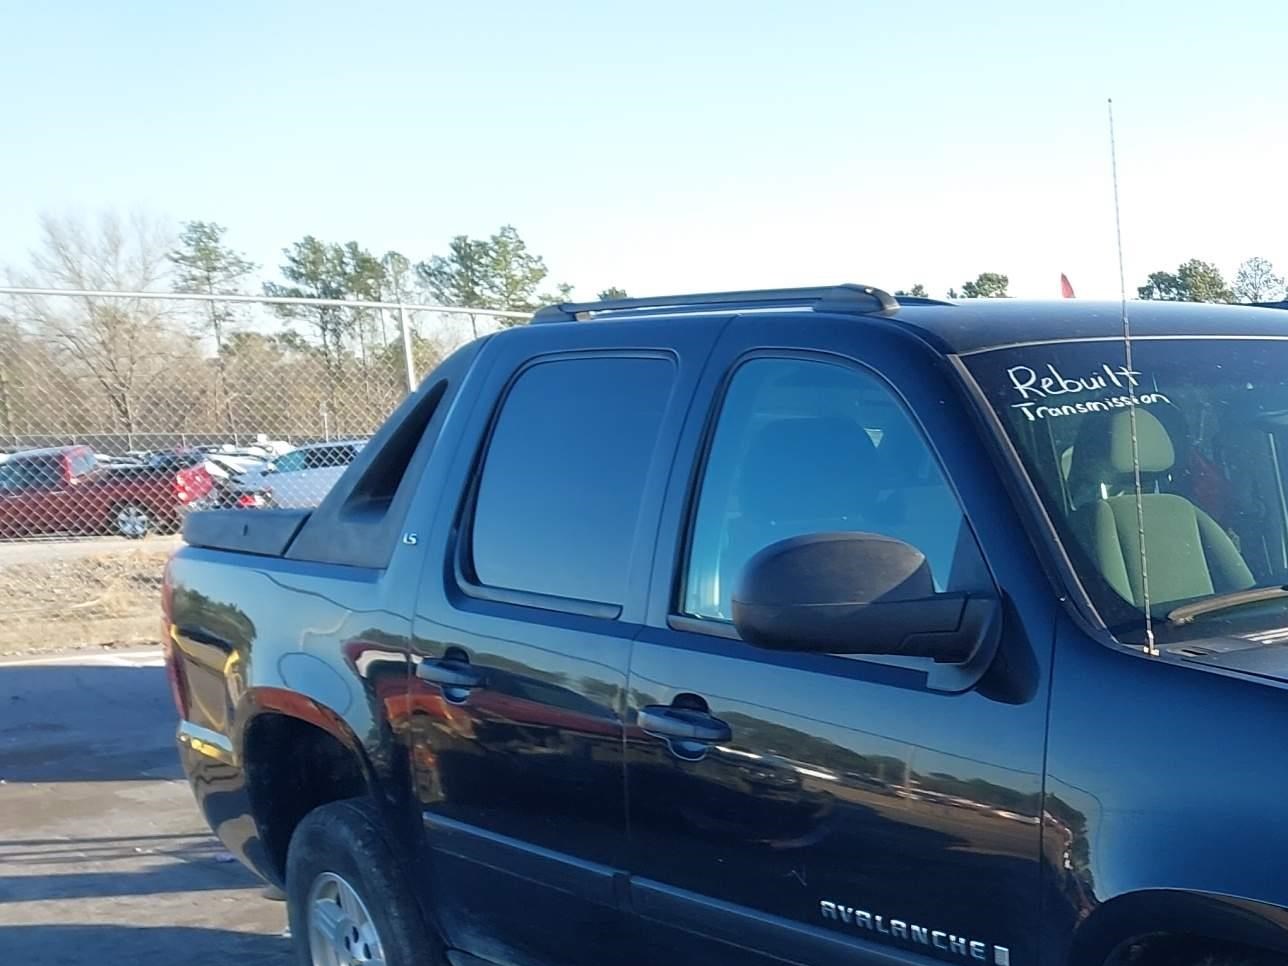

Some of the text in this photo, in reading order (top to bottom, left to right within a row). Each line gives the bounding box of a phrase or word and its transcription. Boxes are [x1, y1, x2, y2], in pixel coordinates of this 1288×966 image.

[1007, 364, 1142, 399] Rebuilt
[1011, 392, 1170, 421] Transmission
[402, 532, 417, 545] LS
[820, 900, 985, 960] AVALANCHE
